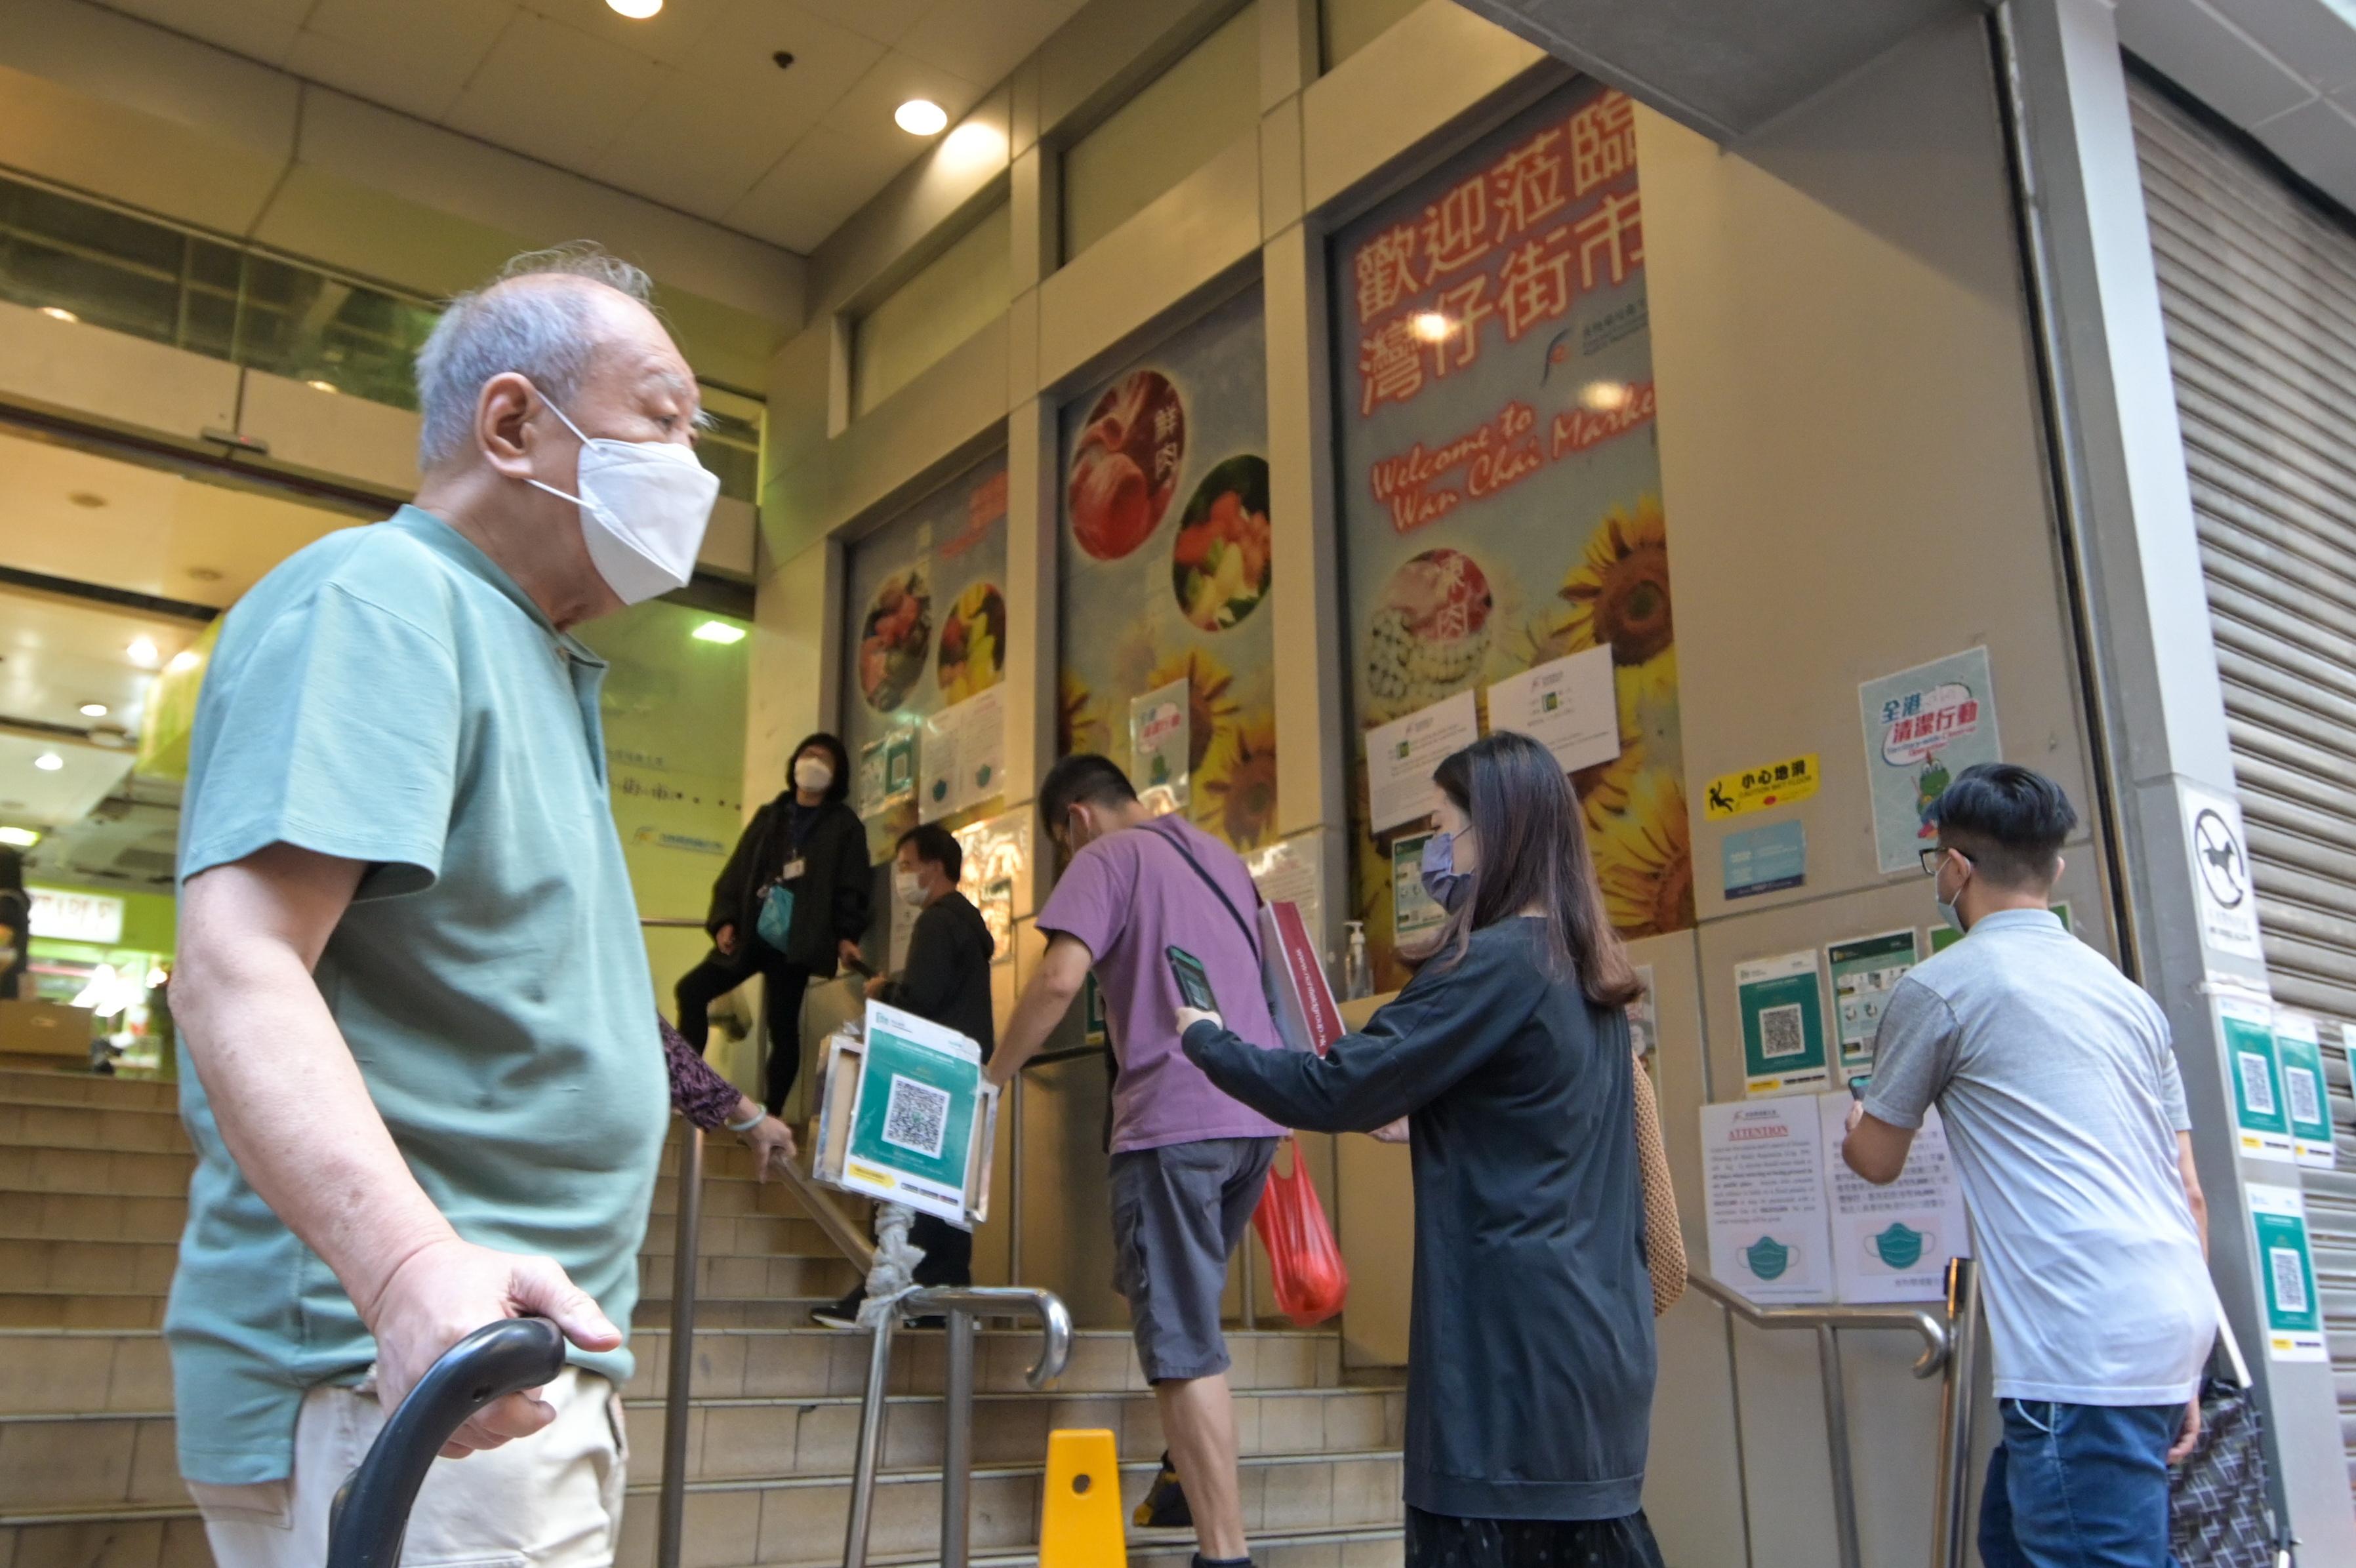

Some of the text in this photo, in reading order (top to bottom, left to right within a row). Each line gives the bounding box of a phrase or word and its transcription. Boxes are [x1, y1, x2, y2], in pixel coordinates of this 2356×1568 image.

[1359, 190, 1644, 416] 灣仔街市
[1372, 402, 1533, 500] Welcome to
[1392, 490, 1458, 531] Wan
[1467, 435, 1540, 497] Chai
[1882, 692, 1921, 724] 全港
[1892, 699, 1979, 744] 清潔行動
[1741, 759, 1806, 790] 小心地滑
[1728, 1125, 1789, 1141] ATTENTION
